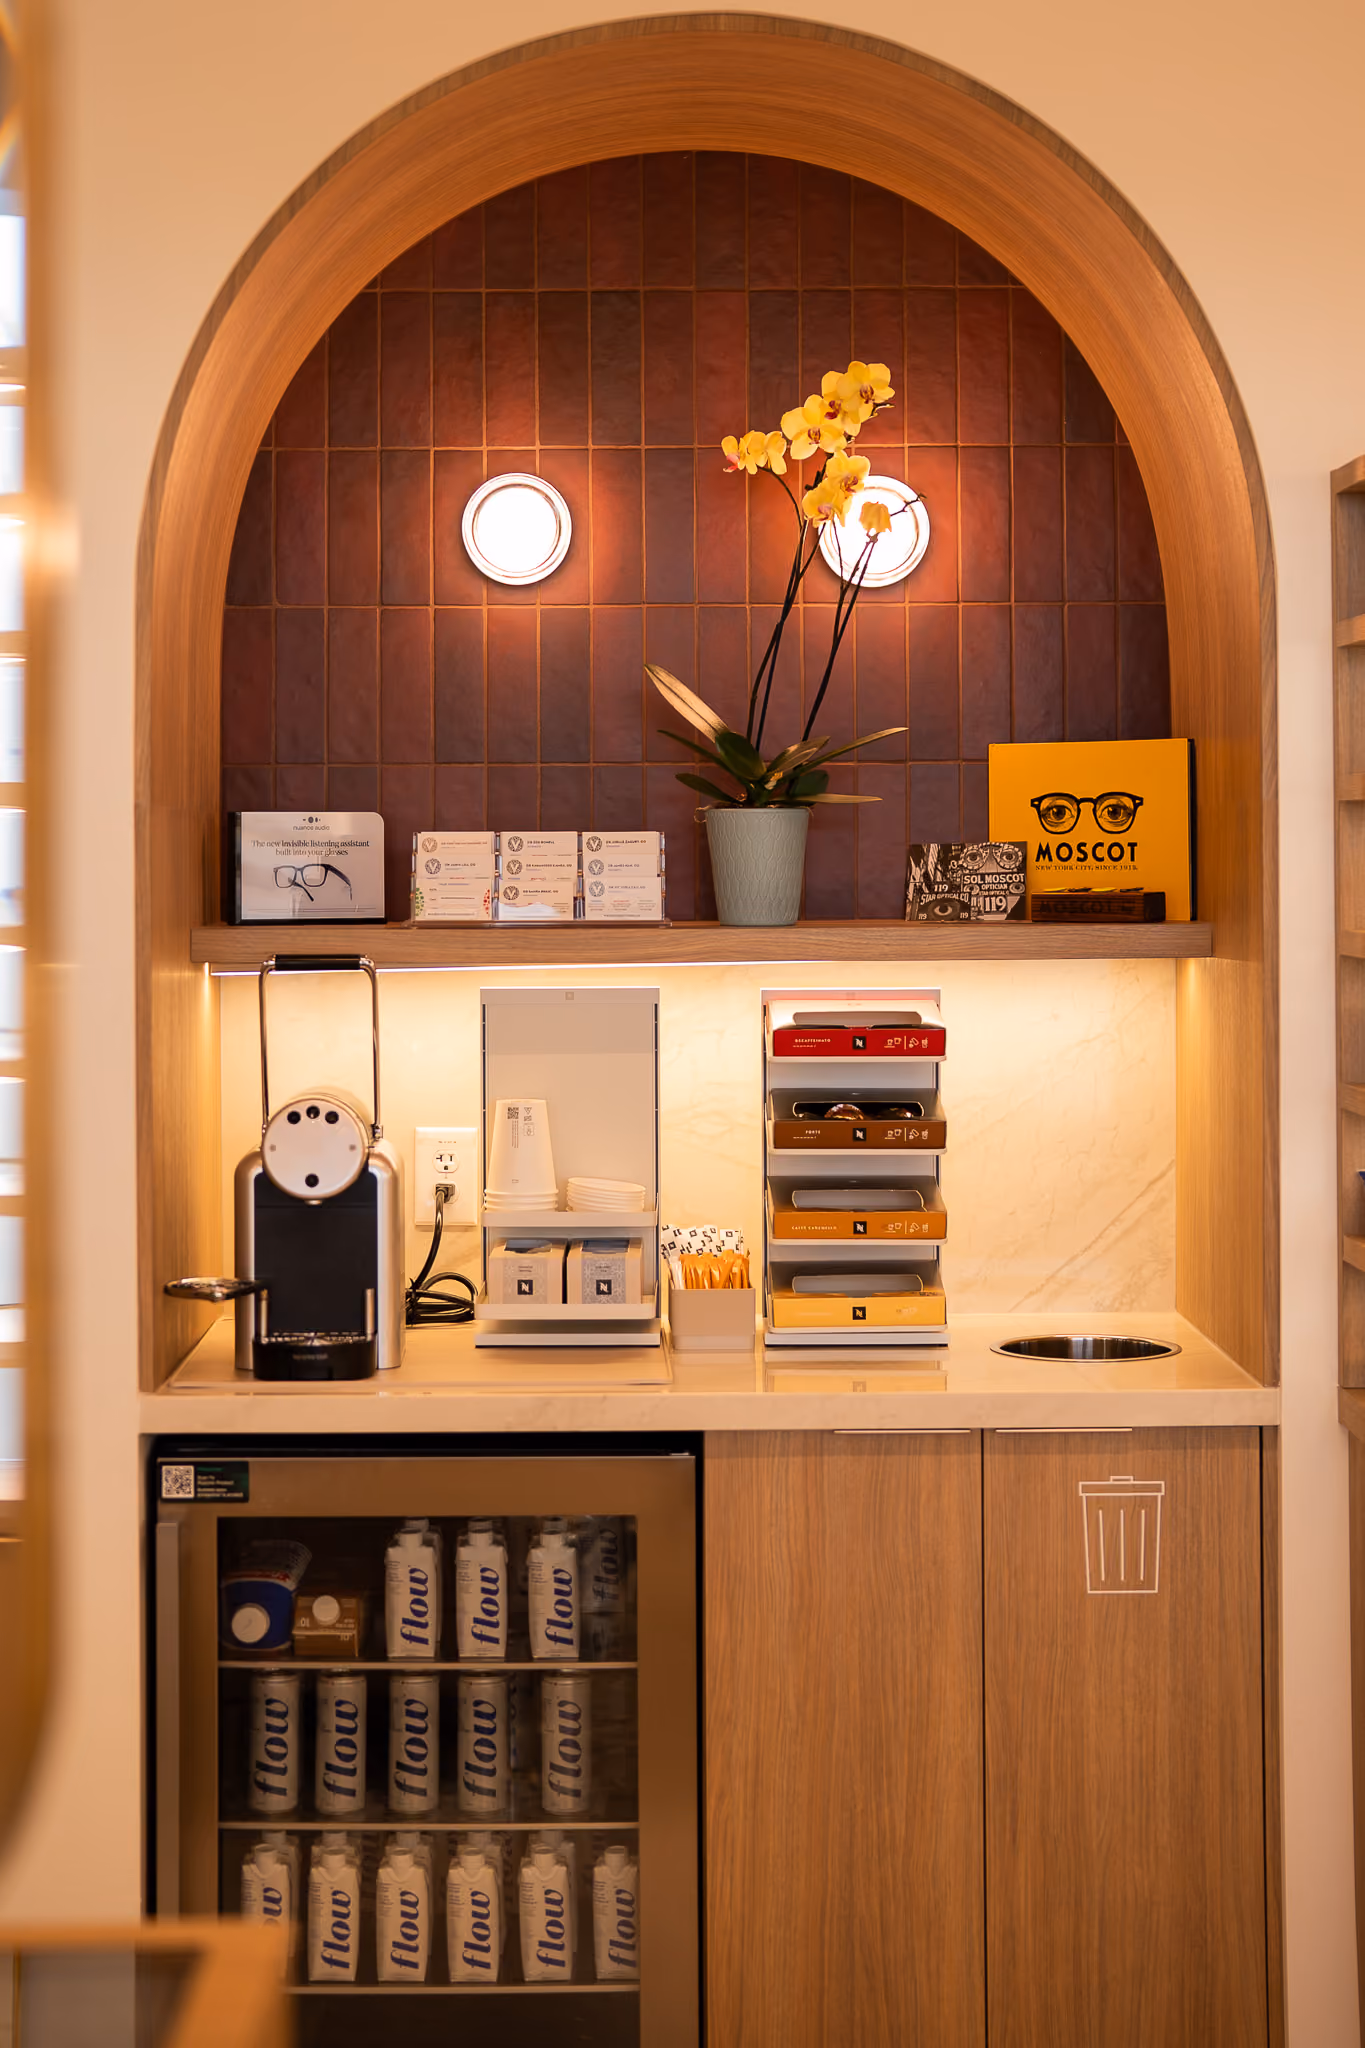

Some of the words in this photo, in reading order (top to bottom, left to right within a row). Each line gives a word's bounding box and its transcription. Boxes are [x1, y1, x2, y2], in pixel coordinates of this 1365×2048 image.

[311, 840, 339, 849] listening
[325, 848, 348, 857] glasses
[963, 875, 984, 884] SOL
[985, 873, 1025, 883] MOSCOT
[1035, 842, 1138, 862] MOSCOT
[920, 893, 937, 905] STAR
[937, 892, 960, 900] OPTICAL
[934, 884, 948, 892] 119
[985, 896, 1007, 911] 119
[400, 1567, 429, 1645] flow
[472, 1566, 500, 1645] flow
[546, 1567, 574, 1646] flow
[254, 1698, 288, 1797] flow
[323, 1699, 358, 1798] flow
[393, 1699, 428, 1797] flow
[463, 1699, 497, 1797] flow
[548, 1699, 582, 1798] flow
[263, 1886, 283, 1927] ow
[321, 1889, 352, 1969] flow
[390, 1889, 419, 1969] flow
[463, 1889, 491, 1969] flow
[536, 1888, 564, 1968] flow
[608, 1888, 636, 1968] flow
